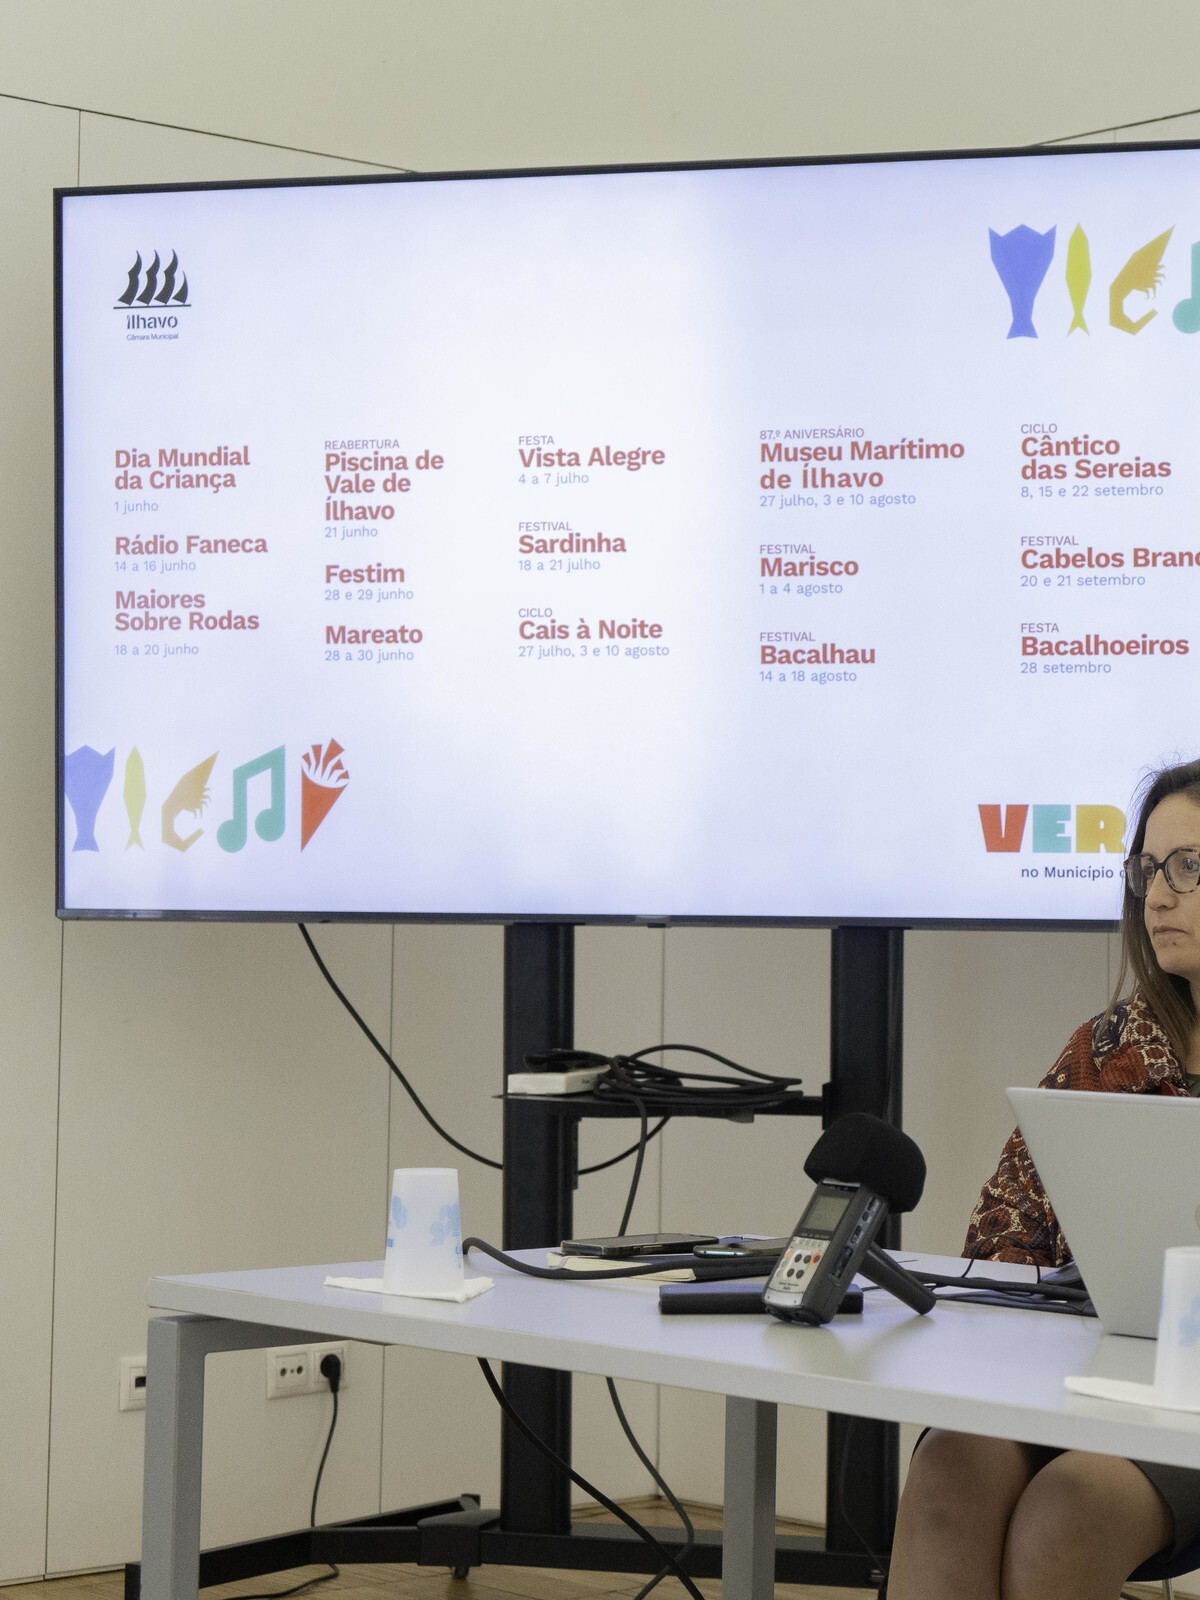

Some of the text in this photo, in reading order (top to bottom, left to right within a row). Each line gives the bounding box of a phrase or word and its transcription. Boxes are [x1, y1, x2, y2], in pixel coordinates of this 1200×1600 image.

[784, 425, 864, 439] ANIVERSÁRIO
[1021, 423, 1057, 434] CICLO
[325, 439, 400, 450] REABERTURA
[519, 436, 554, 445] FESTA
[1022, 434, 1120, 457] Cântico
[116, 446, 250, 468] Dia Mundial
[519, 446, 665, 471] Vista Alegre
[761, 438, 964, 464] Museu Marítimo
[326, 450, 444, 472] Piscina de
[1022, 456, 1171, 480] das Sereias
[115, 469, 236, 493] da Criança
[325, 473, 411, 493] Vale de
[518, 472, 589, 487] 4 a 7 julho
[760, 463, 883, 489] de Ílhavo
[1021, 483, 1163, 499] 8, 15 e 22 setembro
[123, 500, 158, 515] junho
[326, 496, 394, 521] Ílhavo
[760, 494, 916, 509] 27 julho, 3 e 10 agosto
[325, 525, 378, 540] 21 junho
[519, 522, 572, 531] FESTIVAL
[116, 534, 268, 555] Rádio Faneca
[519, 532, 627, 554] Sardinha
[1021, 536, 1079, 546] FESTIVAL
[760, 544, 816, 554] FESTIVAL
[519, 558, 600, 573] 18 a 21 julho
[1022, 547, 1124, 569] Cabelos
[115, 560, 196, 574] 14 a 16 junho
[326, 563, 404, 583] Festim
[761, 555, 859, 577] Marisco
[1021, 573, 1145, 587] 20 e 21 setembro
[325, 588, 413, 603] 28 e 29 junho
[770, 585, 778, 594] a
[783, 583, 791, 594] 4
[797, 583, 842, 597] agosto
[116, 589, 205, 609] Maiores
[115, 610, 259, 631] Sobre Rodas
[519, 608, 552, 618] CICLO
[326, 625, 423, 644] Mareato
[519, 618, 662, 640] Cais à Noite
[1021, 623, 1059, 633] FESTA
[760, 632, 816, 642] FESTIVAL
[115, 644, 127, 655] 18
[144, 644, 159, 655] 20
[163, 643, 199, 658] junho
[519, 645, 669, 660] 27 julho, 3 e 10 agosto
[1022, 634, 1189, 656] Bacalhoeiros
[325, 649, 414, 664] 28 a 30 junho
[761, 643, 875, 664] Bacalhau
[1021, 661, 1111, 673] 28 setembro
[760, 670, 857, 685] 14 a 18 agosto
[1022, 869, 1038, 877] no
[1045, 866, 1113, 881] Município
